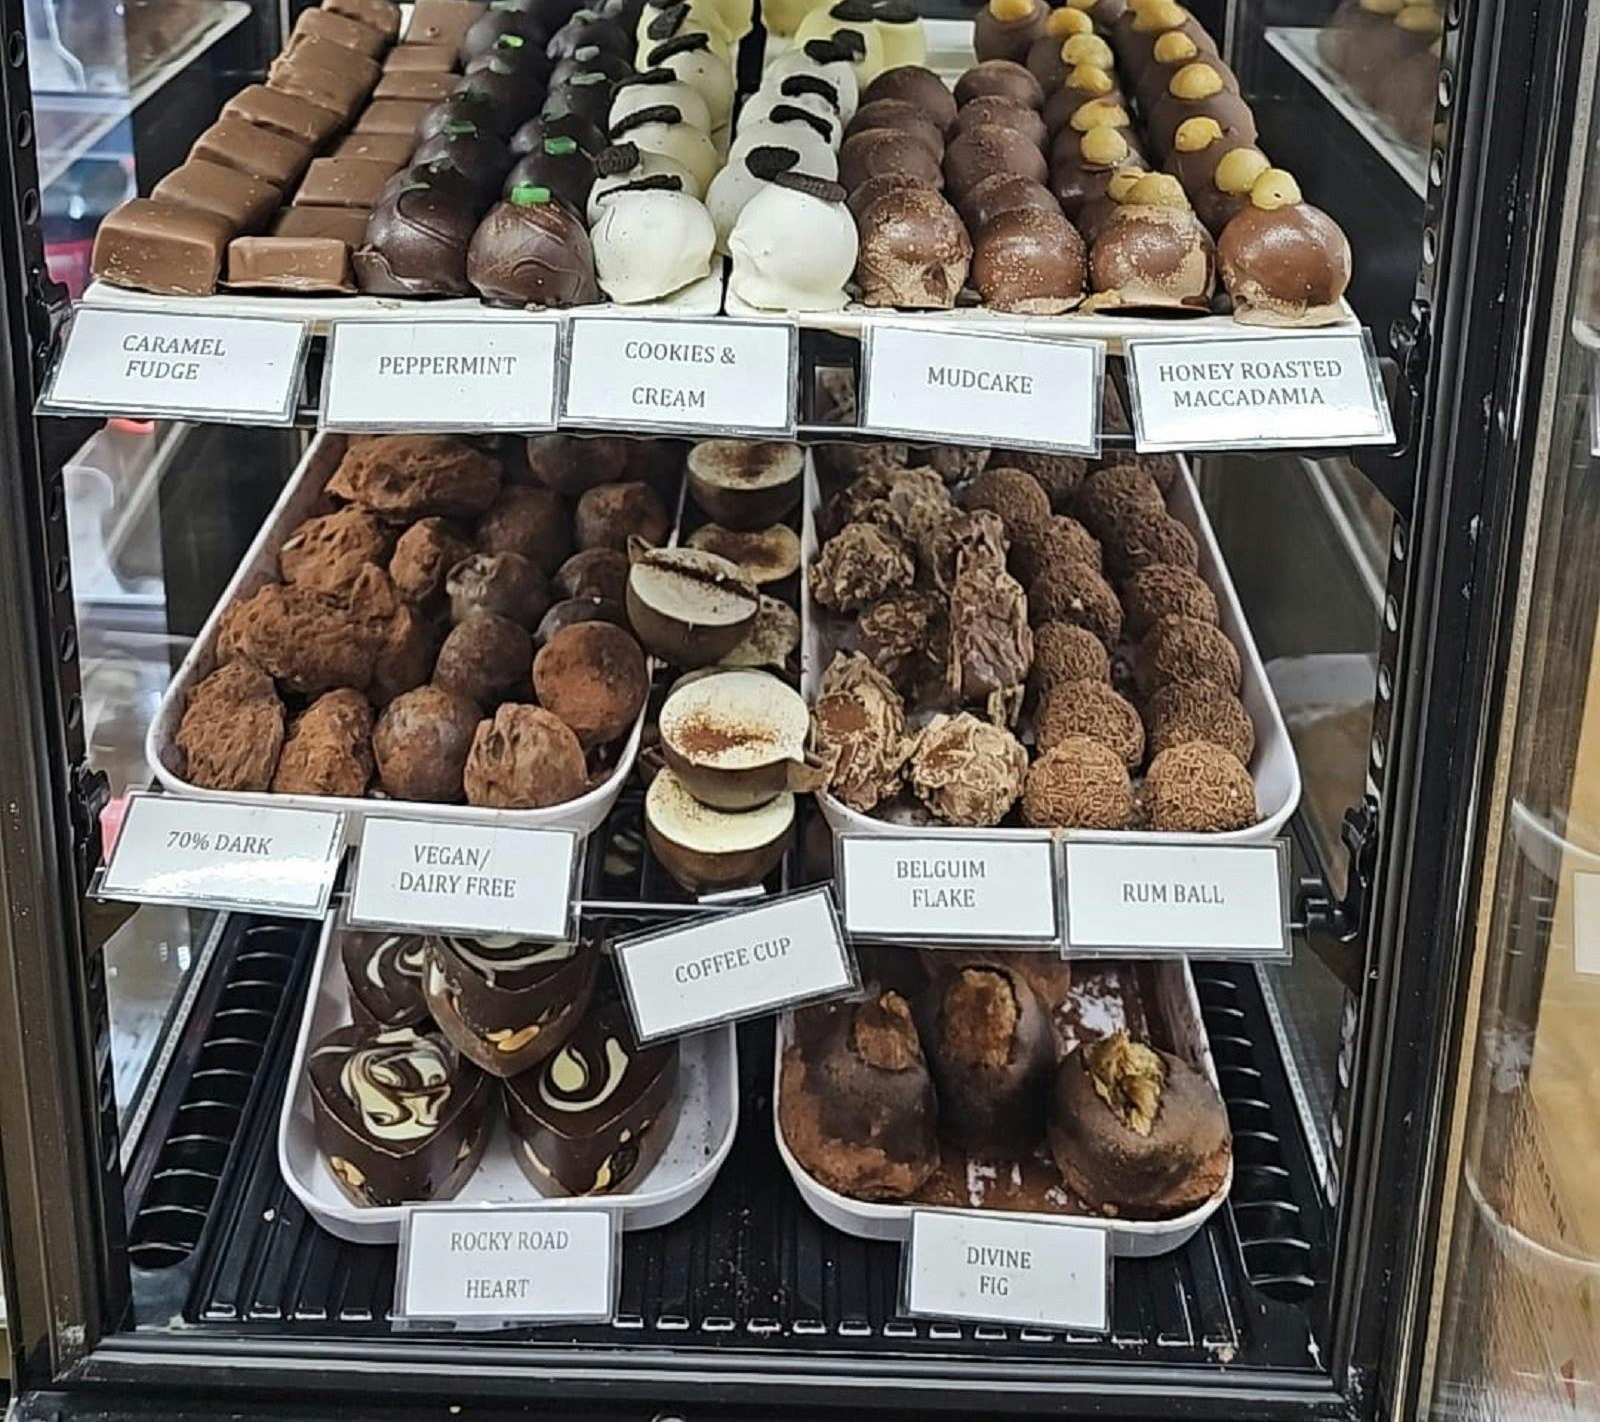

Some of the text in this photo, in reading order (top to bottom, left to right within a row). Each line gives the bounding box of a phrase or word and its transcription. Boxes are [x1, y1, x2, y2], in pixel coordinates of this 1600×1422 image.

[122, 334, 226, 357] CARAMEL
[624, 341, 736, 365] COOKIES &
[125, 359, 200, 380] FUDGE
[378, 355, 517, 376] PEPPERMINT
[1158, 359, 1342, 382] HONEY ROASTED
[927, 366, 1034, 395] MUDCAKE
[631, 386, 705, 409] CREAM
[1172, 386, 1325, 409] MACCADAMIA
[167, 830, 273, 856] 70% DARK
[413, 843, 491, 872] VEGAN/
[896, 859, 986, 880] BELGUIM
[399, 871, 517, 898] DAIRY FREE
[1122, 882, 1225, 905] RUM BALL
[911, 887, 976, 909] FLAKE
[674, 936, 791, 984] COFFEE CUP
[450, 1230, 569, 1252] ROCKY ROAD
[965, 1246, 1032, 1270] DIVINE
[465, 1279, 530, 1300] HEART
[979, 1275, 1009, 1297] FIG
